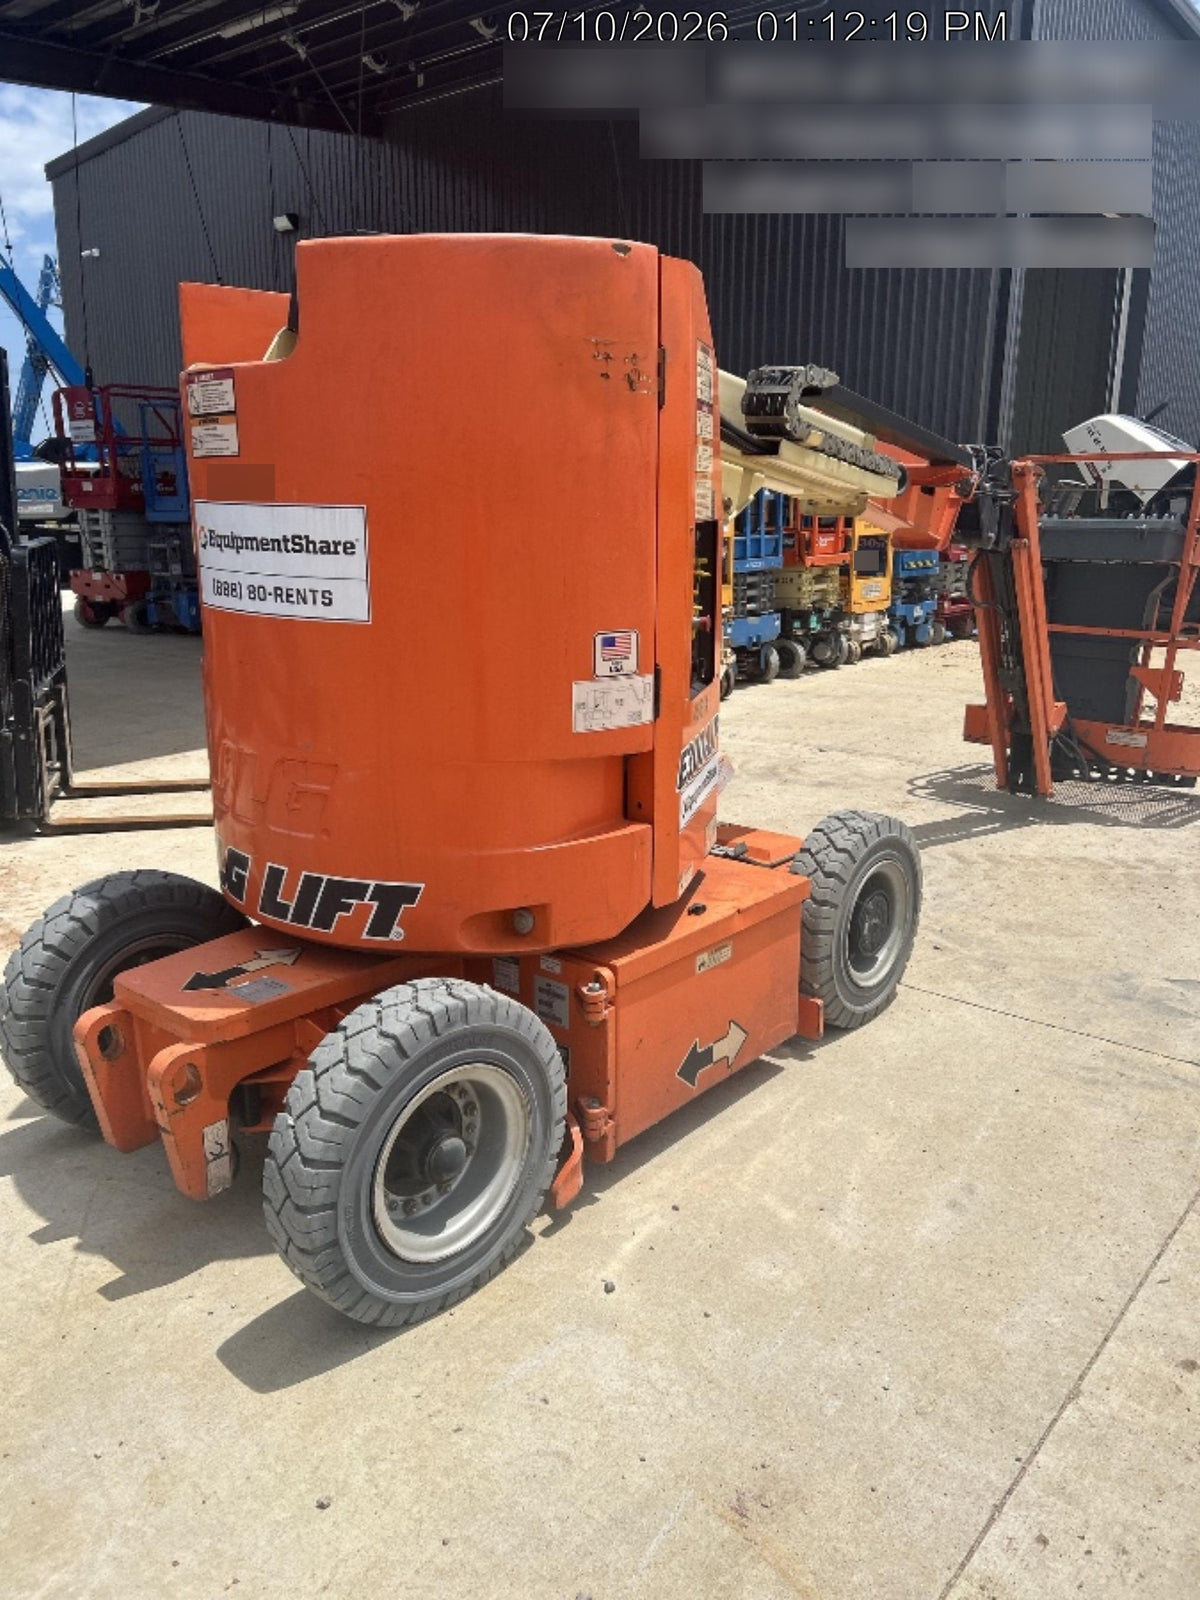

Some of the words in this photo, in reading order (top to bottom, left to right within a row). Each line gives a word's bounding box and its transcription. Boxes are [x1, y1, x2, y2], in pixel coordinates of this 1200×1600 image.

[17, 487, 58, 500] enie
[208, 529, 357, 556] EquipmentShare
[212, 577, 243, 600] (888)
[247, 584, 333, 607] 80-RENTS
[257, 862, 426, 941] LIFT
